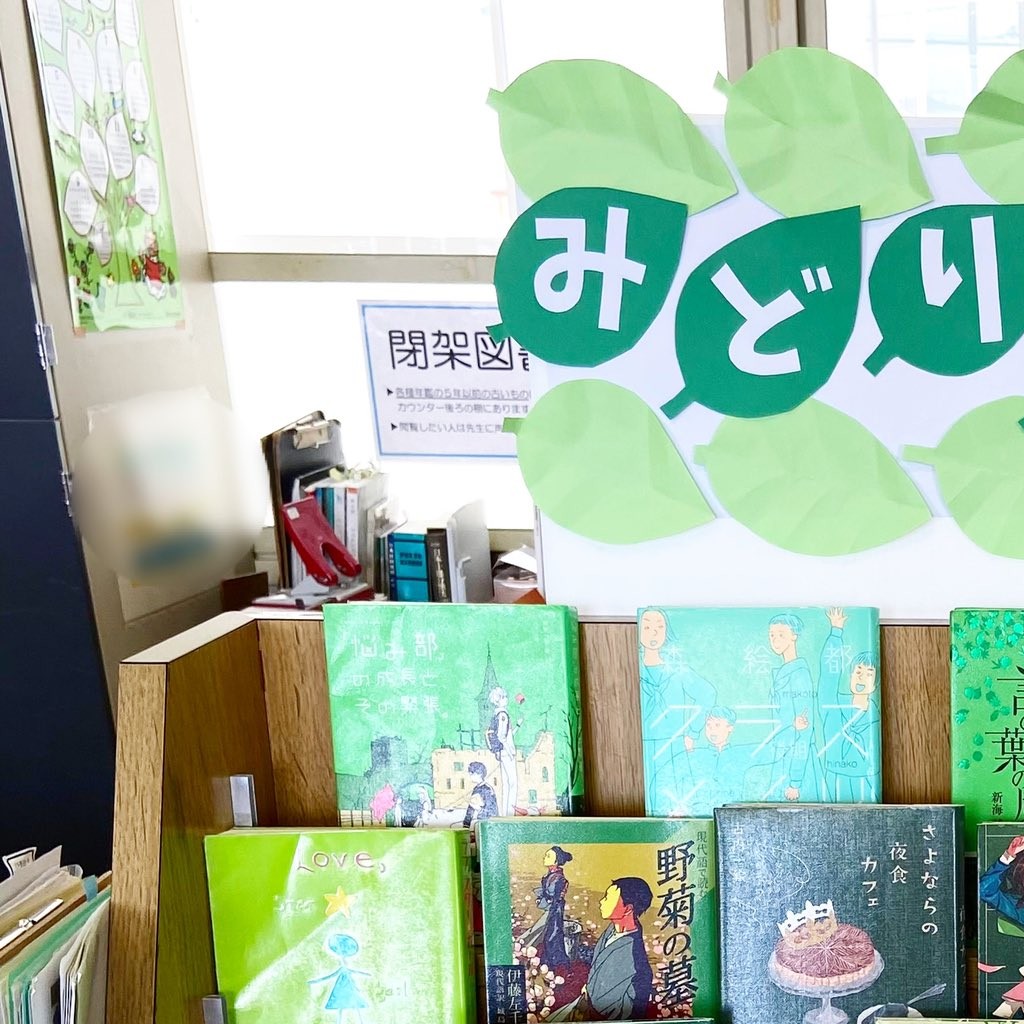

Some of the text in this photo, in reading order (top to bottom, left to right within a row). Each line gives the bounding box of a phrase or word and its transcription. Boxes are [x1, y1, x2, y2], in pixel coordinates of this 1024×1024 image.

[388, 329, 530, 372] 閉架図
[861, 857, 879, 907] カフェ
[889, 842, 908, 884] 夜食
[921, 824, 939, 935] さよならの
[657, 840, 700, 1006] 野菊の墓
